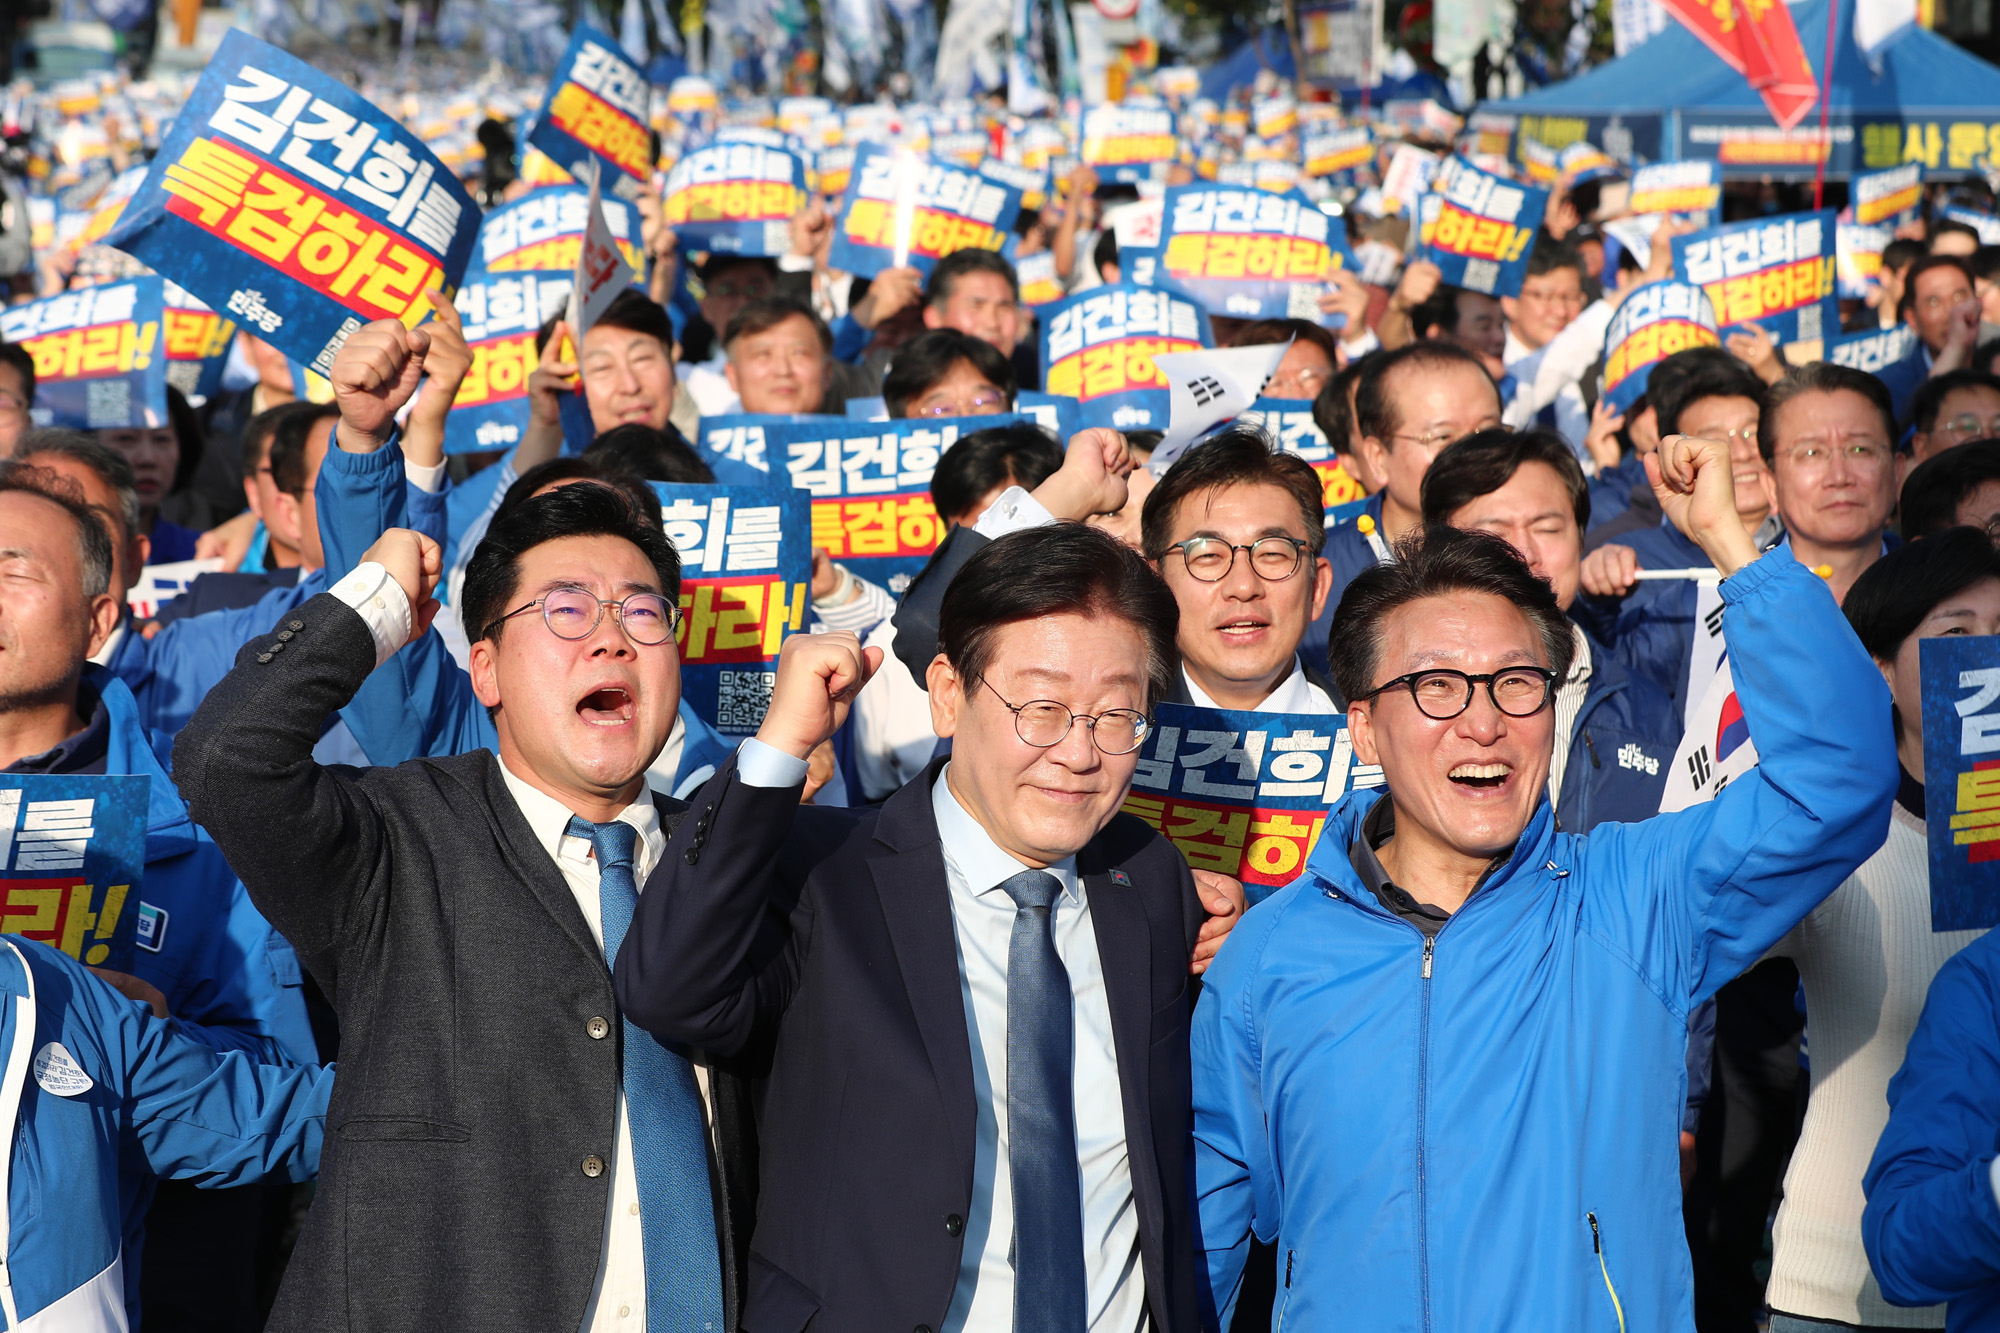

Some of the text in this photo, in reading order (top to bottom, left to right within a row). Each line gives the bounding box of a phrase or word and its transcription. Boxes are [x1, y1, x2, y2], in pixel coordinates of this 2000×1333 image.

[208, 65, 462, 257] 김건희를
[161, 137, 455, 331] 특검하라
[1173, 190, 1328, 242] 김건희를
[1684, 219, 1822, 284] 김건희를
[1048, 289, 1199, 363] 김건희를
[1618, 748, 1660, 776] 민주당
